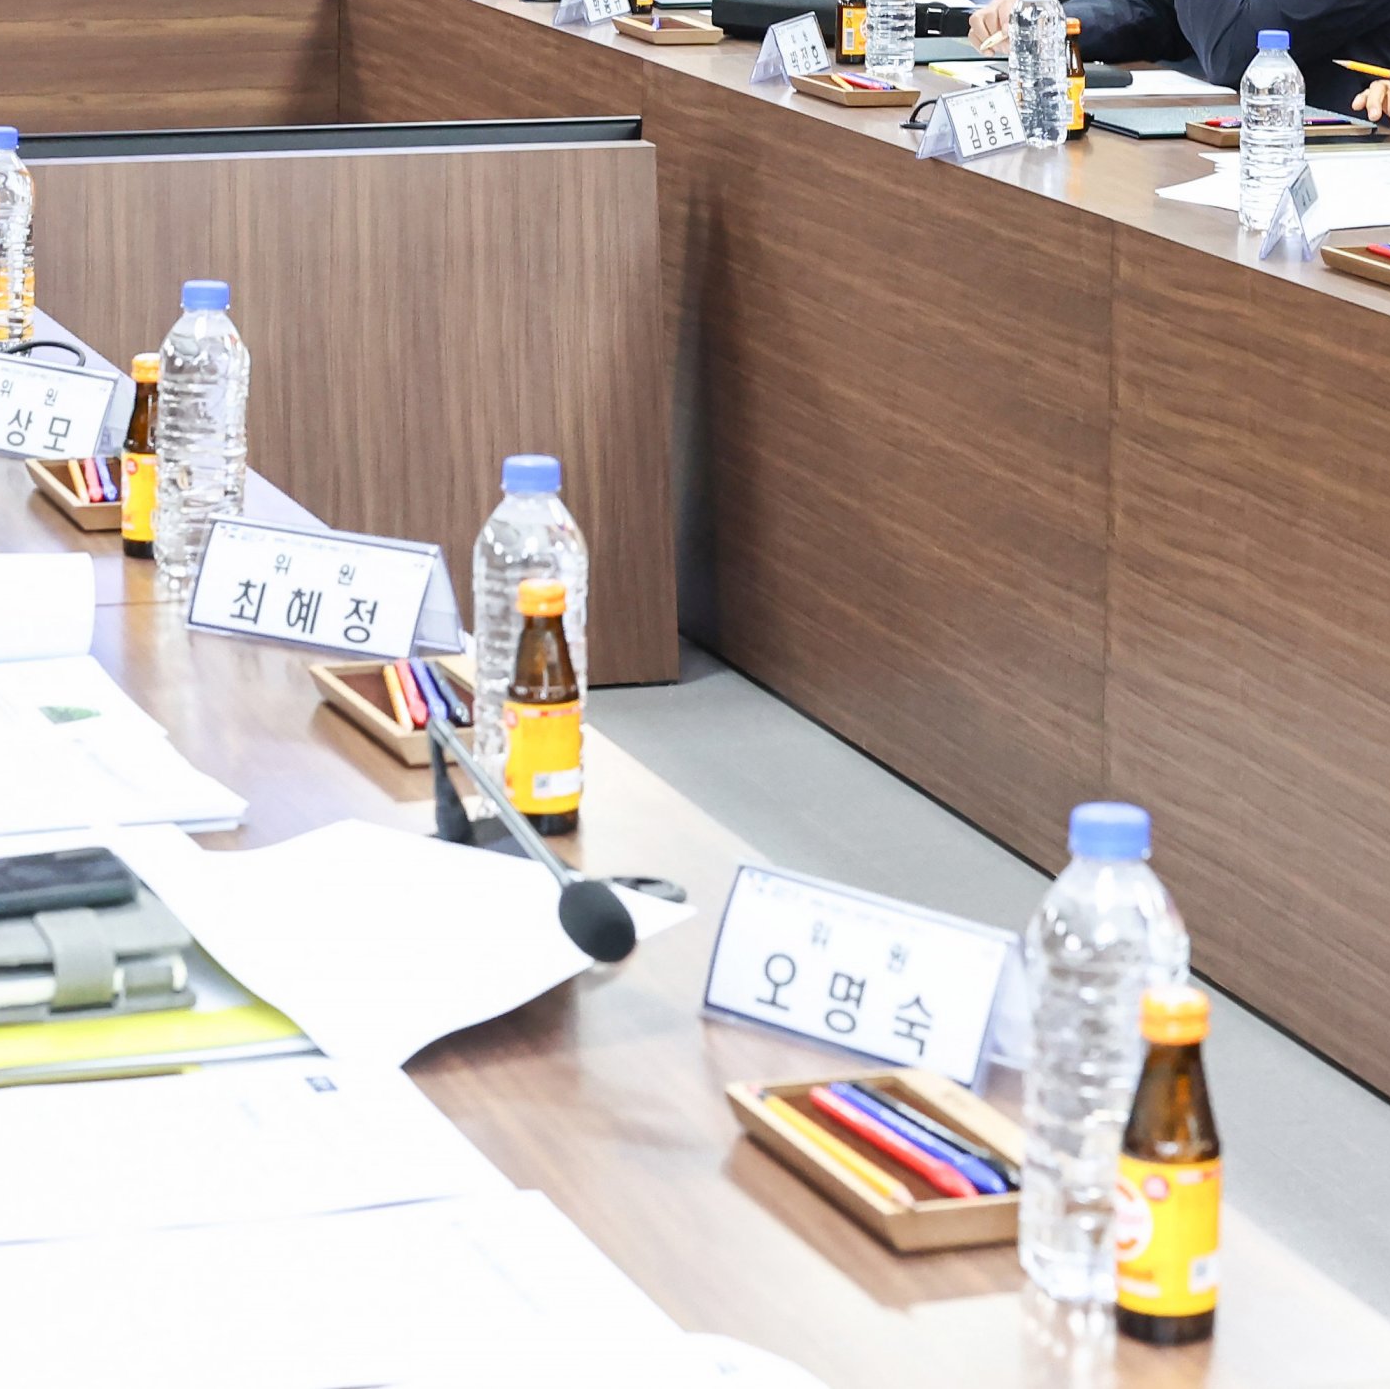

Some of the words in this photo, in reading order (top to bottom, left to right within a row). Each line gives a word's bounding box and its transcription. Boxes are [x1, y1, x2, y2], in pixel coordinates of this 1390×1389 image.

[966, 115, 1015, 150] 김용옥
[229, 578, 379, 644] 최혜정
[755, 952, 933, 1057] 오명숙
